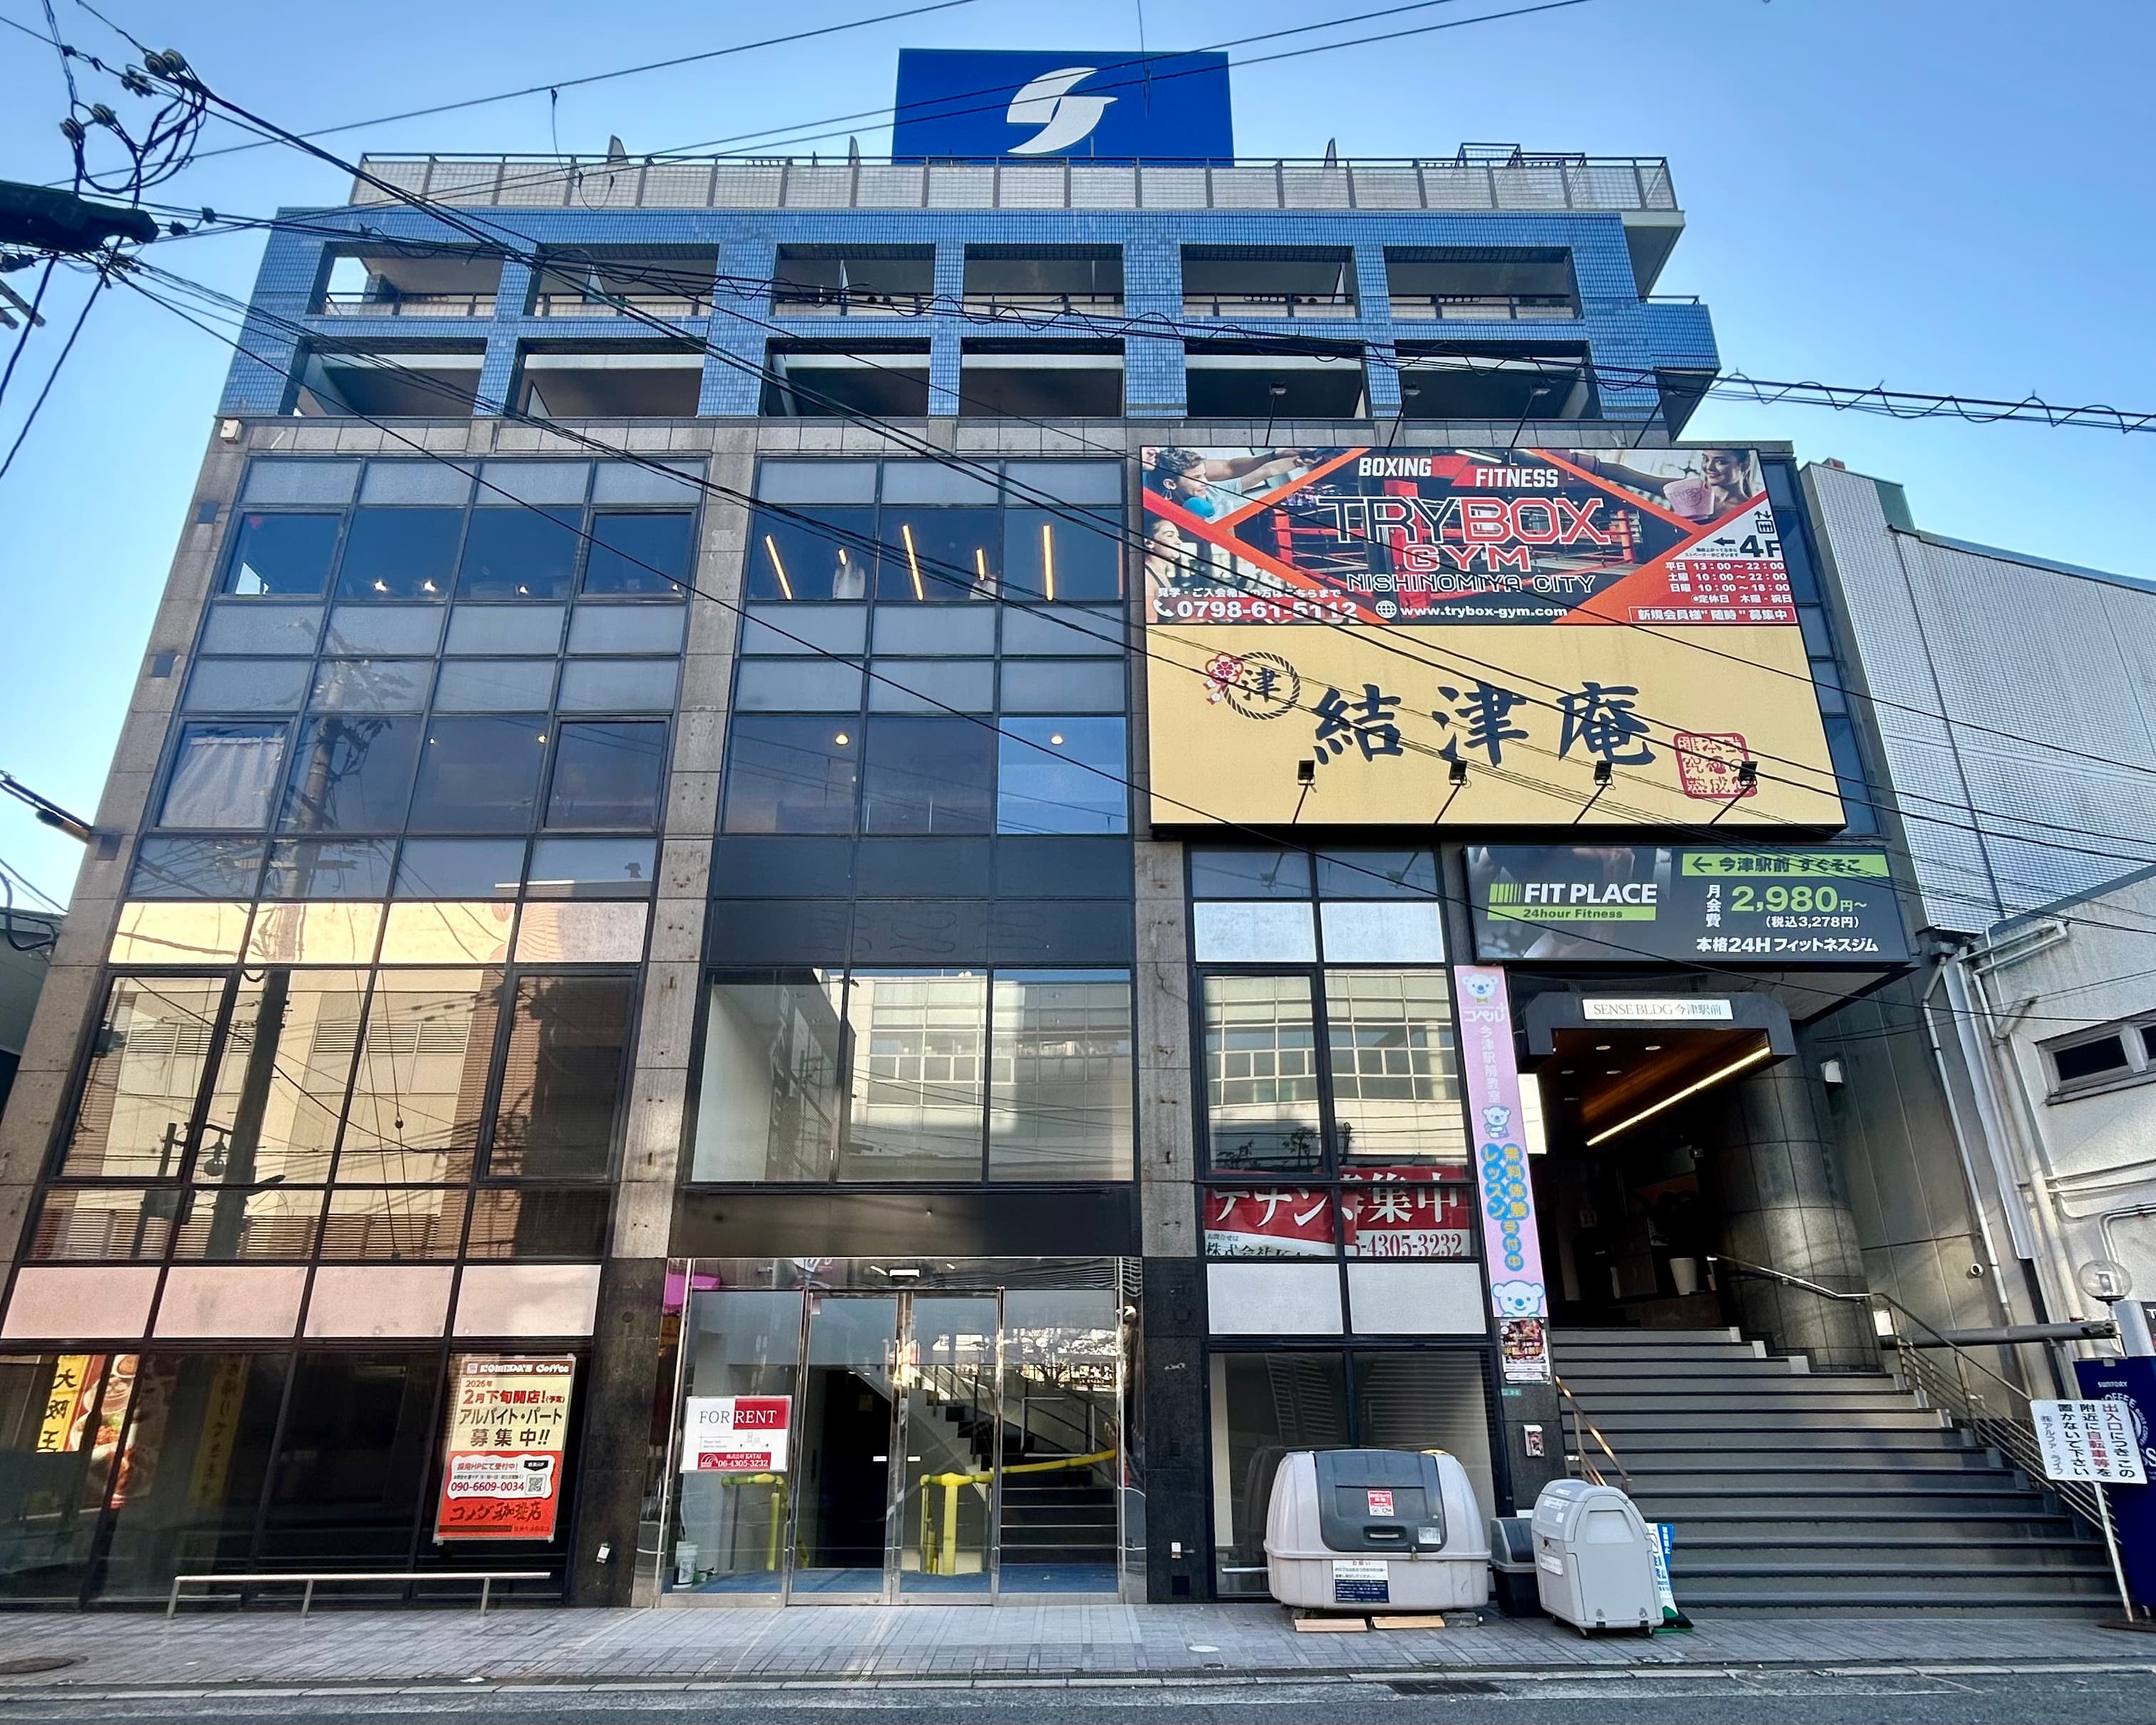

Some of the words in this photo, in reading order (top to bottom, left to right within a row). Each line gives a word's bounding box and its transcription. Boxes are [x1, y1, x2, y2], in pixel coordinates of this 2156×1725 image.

[1358, 457, 1432, 477] BOXING
[1475, 469, 1559, 488] FITNESS
[1316, 496, 1611, 544] TRYBOX
[1740, 536, 1780, 558] 4F
[1404, 544, 1531, 572] GYM
[1347, 574, 1522, 593] NISHINOMIYA
[1533, 575, 1596, 593] CITY
[1668, 573, 1689, 581] 土曜
[1177, 601, 1357, 618] 0798-61-5112
[1400, 605, 1567, 620] www.trybox-gym.com
[1312, 682, 1656, 768] 結津庵
[1719, 858, 1790, 872] 今津駅前
[1798, 859, 1861, 872] すぐそこ
[1524, 884, 1566, 904] FIT
[1570, 884, 1658, 904] PLACE
[1523, 909, 1571, 918] 24hour
[1574, 909, 1623, 918] Fitness
[1706, 884, 1722, 927] 月会費
[1766, 916, 1859, 928] (税込3,278円)
[1593, 1003, 1635, 1015] SENSE
[1636, 1003, 1673, 1015] BLDG
[1674, 1003, 1722, 1015] 今津駅前
[1484, 1147, 1506, 1215] レッスン
[1505, 1147, 1528, 1217] 無料体験
[536, 1363, 570, 1373] Coffee
[459, 1407, 563, 1425] アルバイト・パート
[699, 1411, 730, 1424] FOR
[734, 1410, 777, 1424] RENT
[2058, 1404, 2089, 1475] 置かないで下さい
[2102, 1403, 2136, 1478] 出入口につきこの
[451, 1482, 524, 1491] 090-6609-0034
